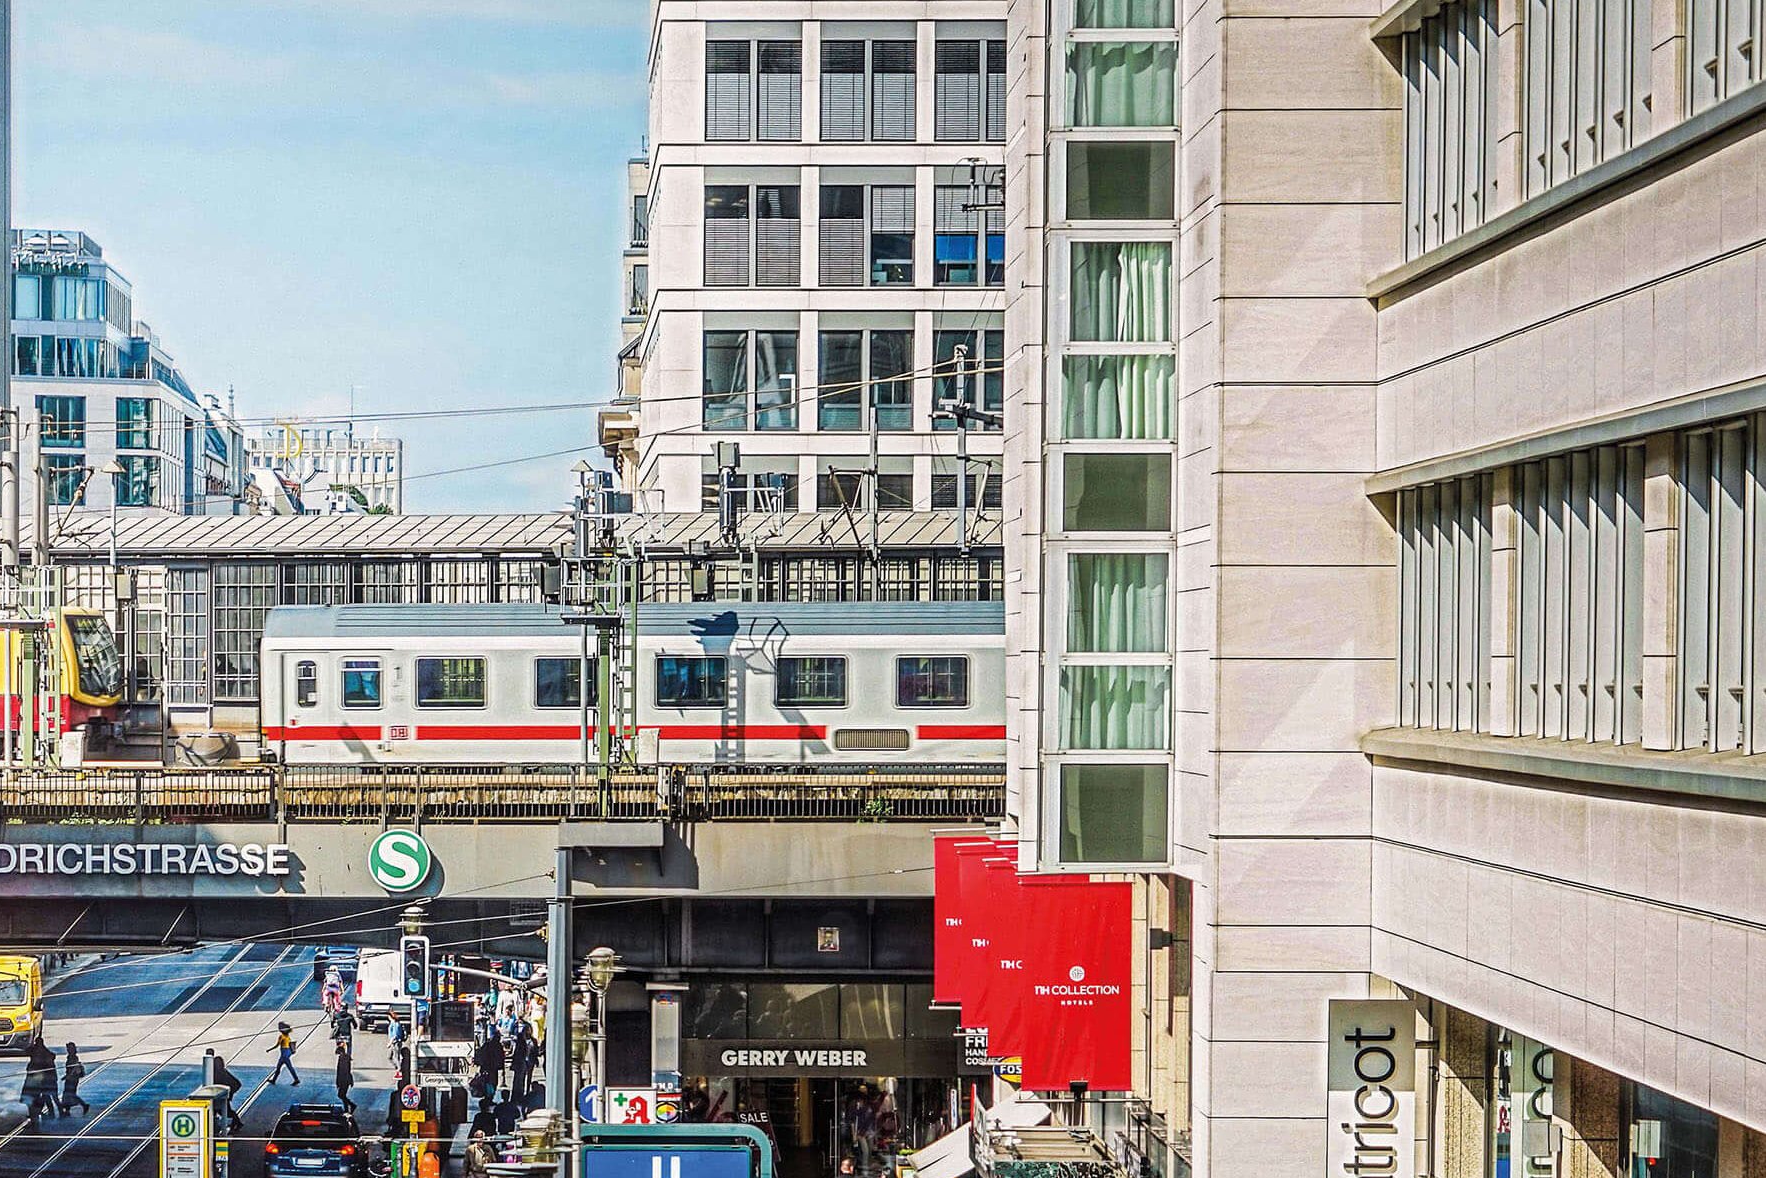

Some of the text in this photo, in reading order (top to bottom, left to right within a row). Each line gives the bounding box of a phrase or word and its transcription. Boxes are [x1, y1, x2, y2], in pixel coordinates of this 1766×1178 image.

[377, 838, 424, 884] S
[1052, 985, 1120, 996] COLLECTION
[721, 1048, 867, 1068] GERRY WEBER
[739, 1113, 769, 1123] SALE
